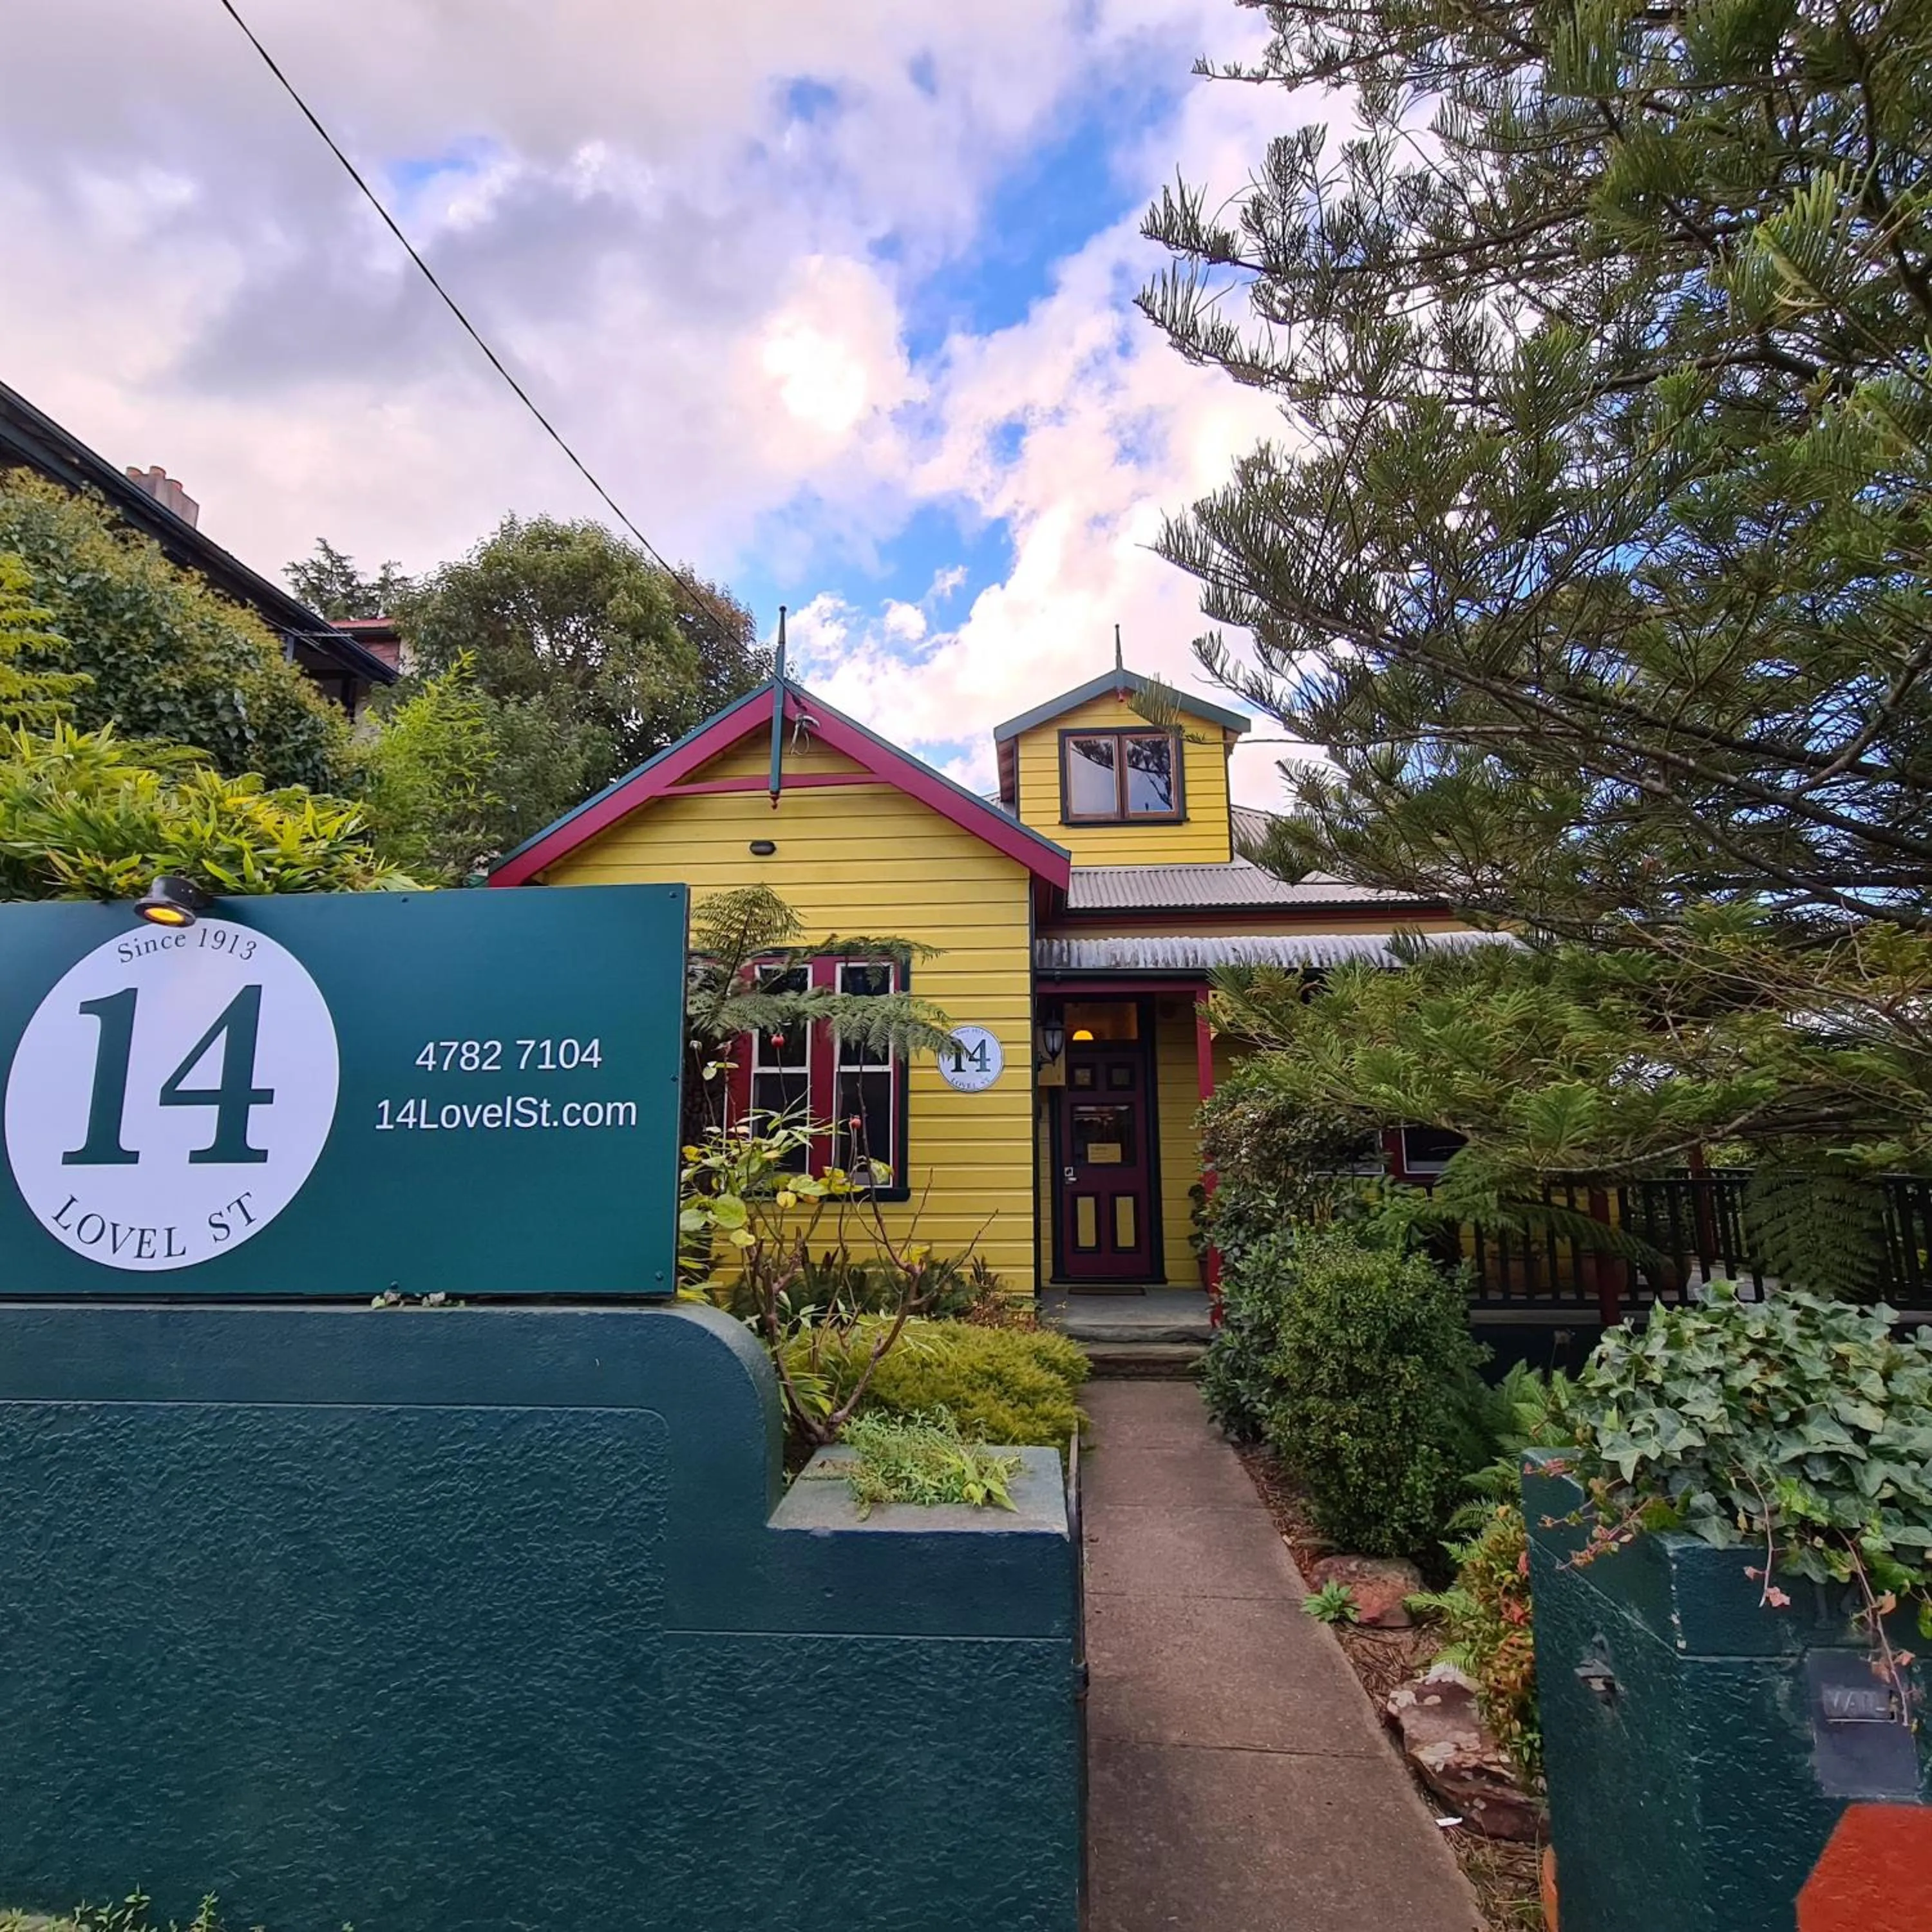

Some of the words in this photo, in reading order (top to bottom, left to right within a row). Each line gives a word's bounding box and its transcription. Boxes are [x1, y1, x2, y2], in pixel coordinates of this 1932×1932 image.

[118, 933, 187, 963] Since
[197, 927, 258, 961] 1913
[415, 1039, 503, 1072] 4782
[515, 1038, 603, 1070] 7104
[950, 1038, 991, 1072] 14
[61, 984, 274, 1166] 14
[375, 1095, 638, 1130] 14LovelSt.com
[51, 1194, 187, 1259] LOVEL
[207, 1191, 257, 1244] ST
